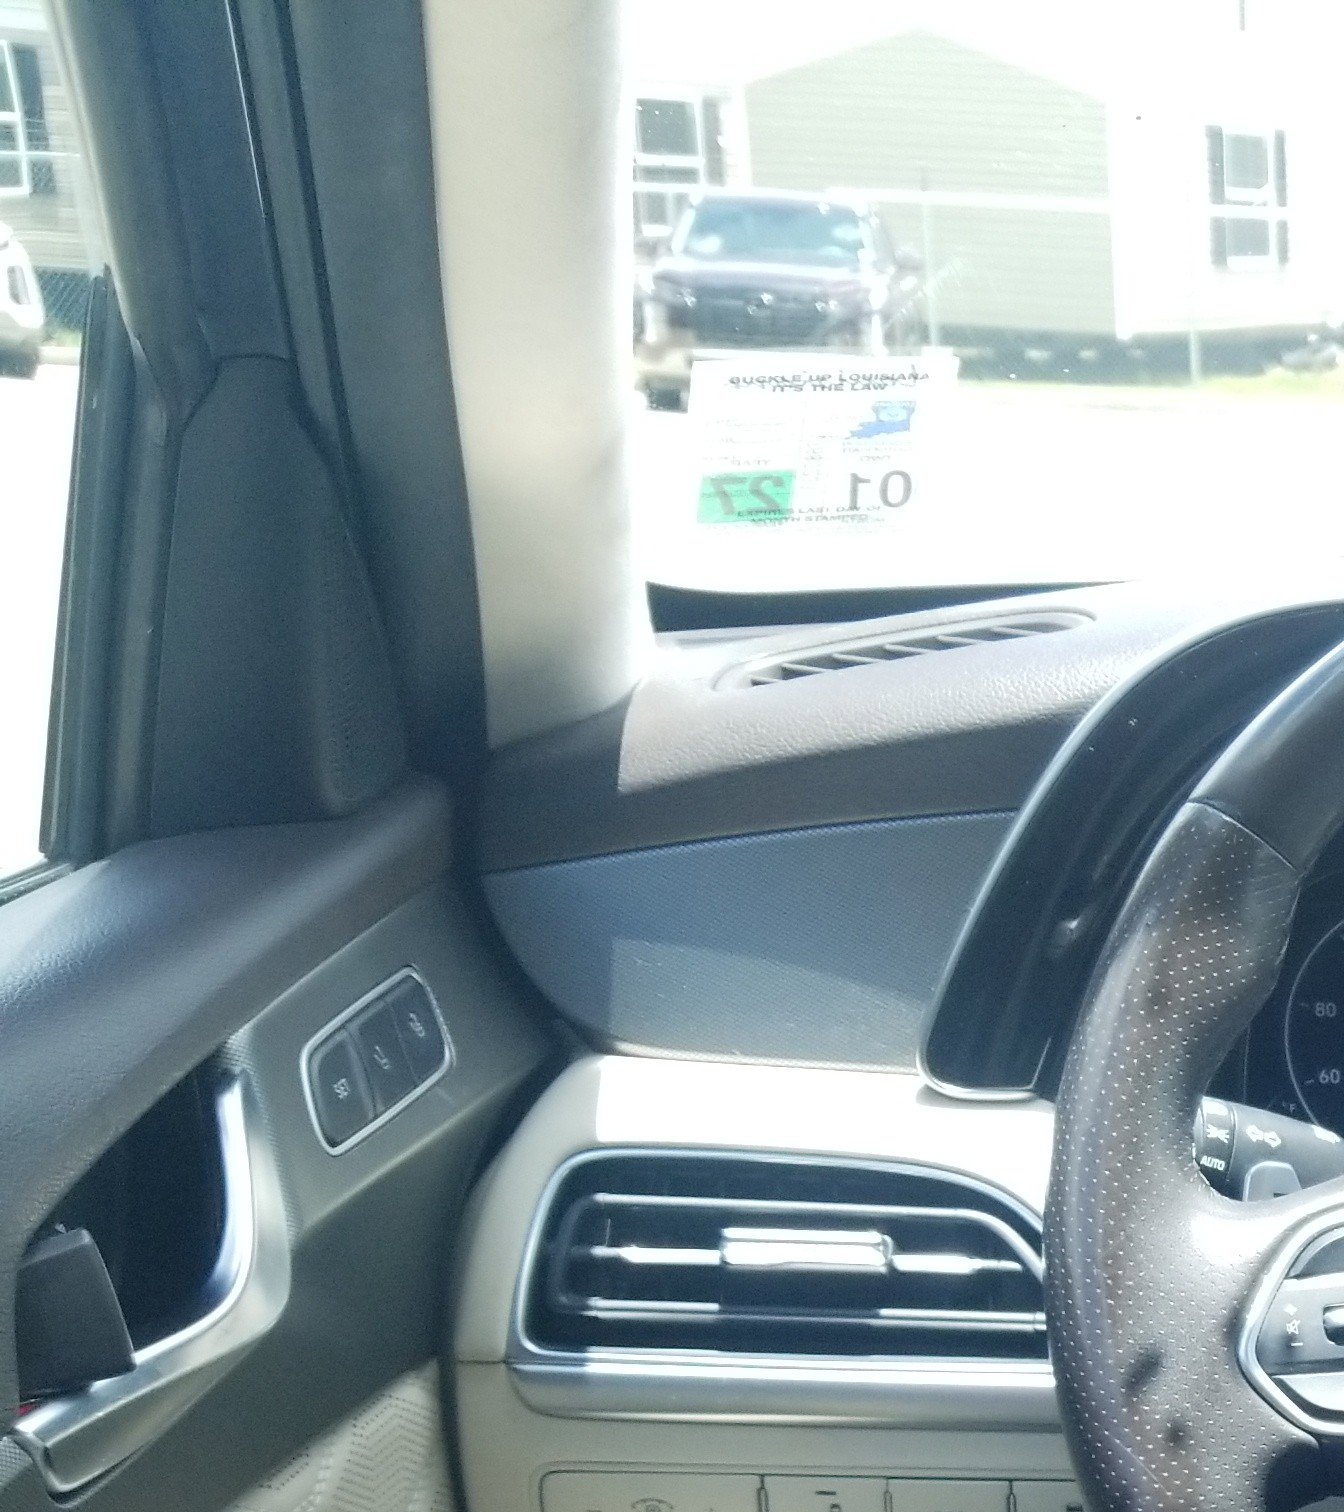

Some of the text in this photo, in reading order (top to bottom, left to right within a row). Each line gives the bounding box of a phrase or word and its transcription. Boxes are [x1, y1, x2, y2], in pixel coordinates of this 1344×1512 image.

[808, 374, 832, 383] UP
[812, 383, 844, 391] THE
[850, 382, 888, 391] LAW
[1314, 1003, 1337, 1018] 80
[1319, 1069, 1341, 1084] 60
[1200, 1155, 1226, 1171] AUTO
